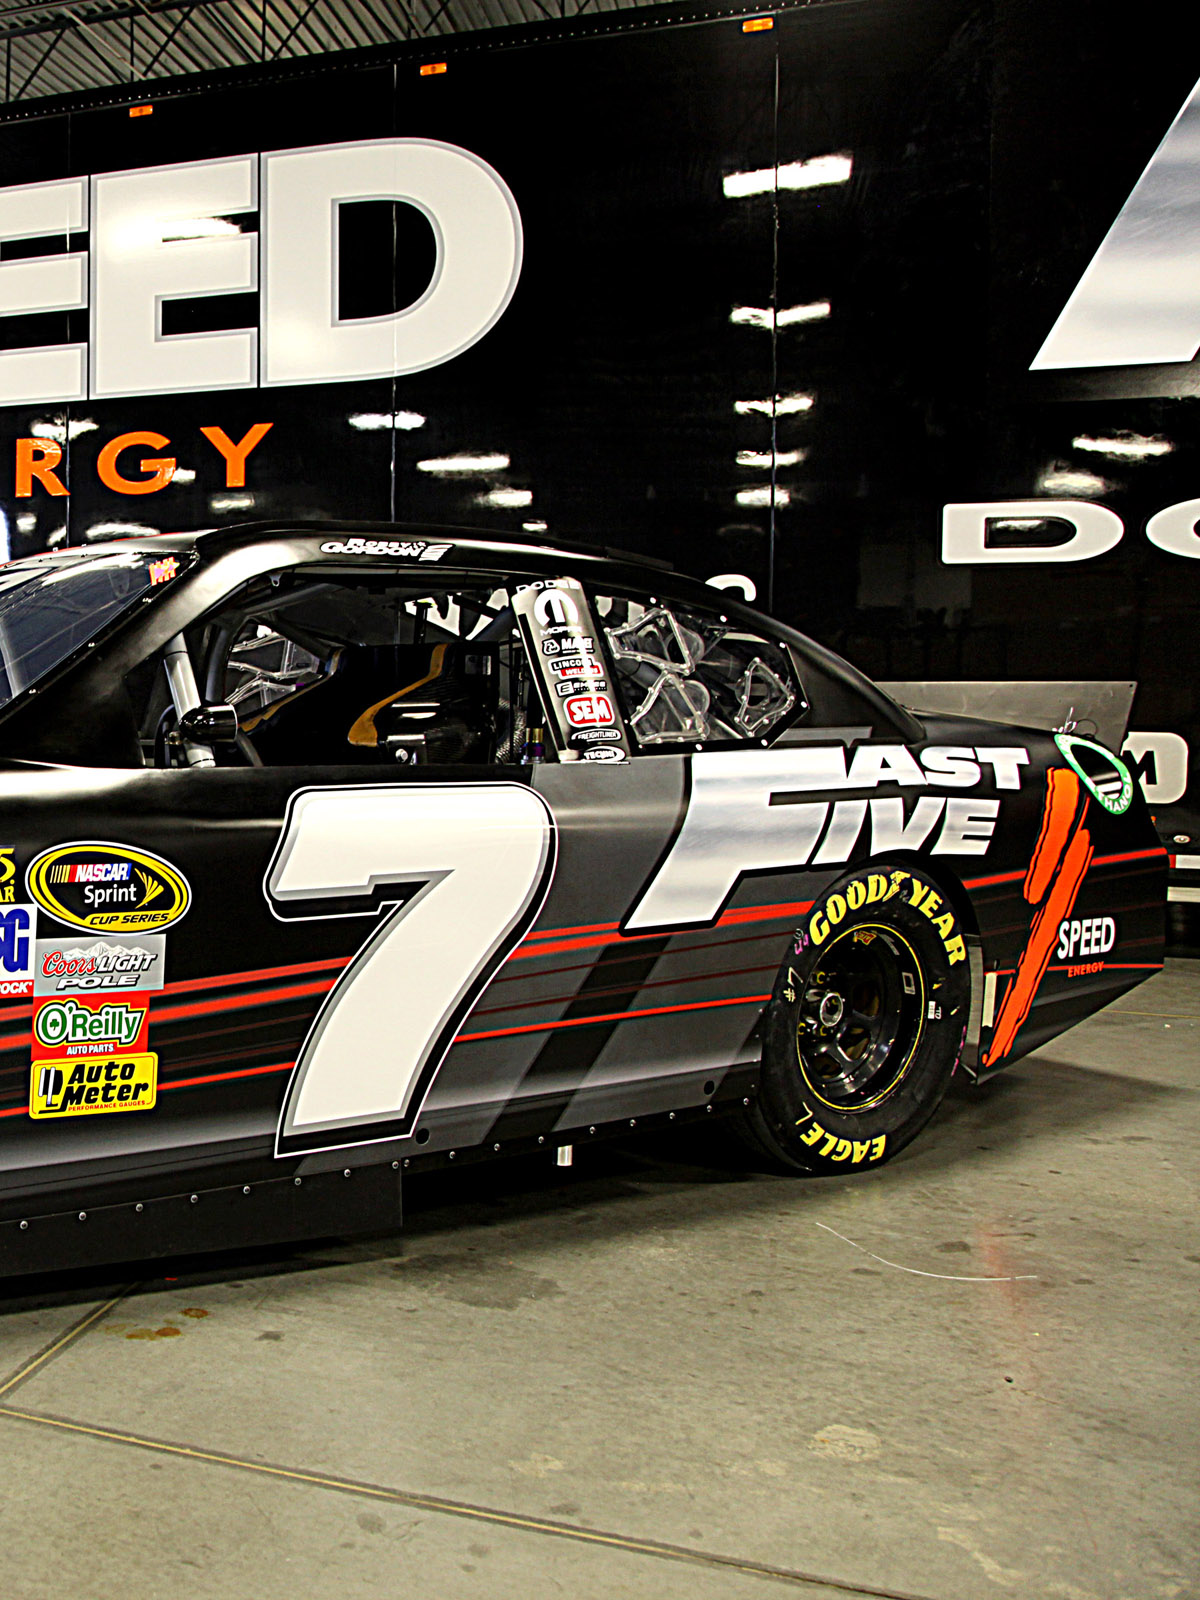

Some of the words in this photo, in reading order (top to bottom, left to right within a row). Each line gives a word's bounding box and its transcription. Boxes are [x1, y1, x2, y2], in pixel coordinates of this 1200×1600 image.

[570, 699, 611, 722] SEM
[74, 863, 130, 883] NASCAR
[84, 883, 137, 908] Sprint
[89, 915, 119, 926] CUP
[121, 912, 170, 924] SERIES
[1057, 916, 1116, 960] SPEED
[41, 951, 98, 977] Coors
[97, 953, 158, 973] LIGHT
[265, 783, 556, 1152] 7
[1067, 961, 1104, 978] ENERGY
[55, 974, 141, 992] POLE
[41, 1005, 138, 1041] O'Reilly
[66, 1045, 88, 1055] AUTO
[88, 1043, 114, 1054] PARTS
[67, 1061, 136, 1085] Auto
[60, 1082, 150, 1108] Meter
[68, 1102, 117, 1111] PERFORMANCE
[118, 1100, 146, 1108] GAUGES
[799, 1121, 887, 1164] EAGLE
